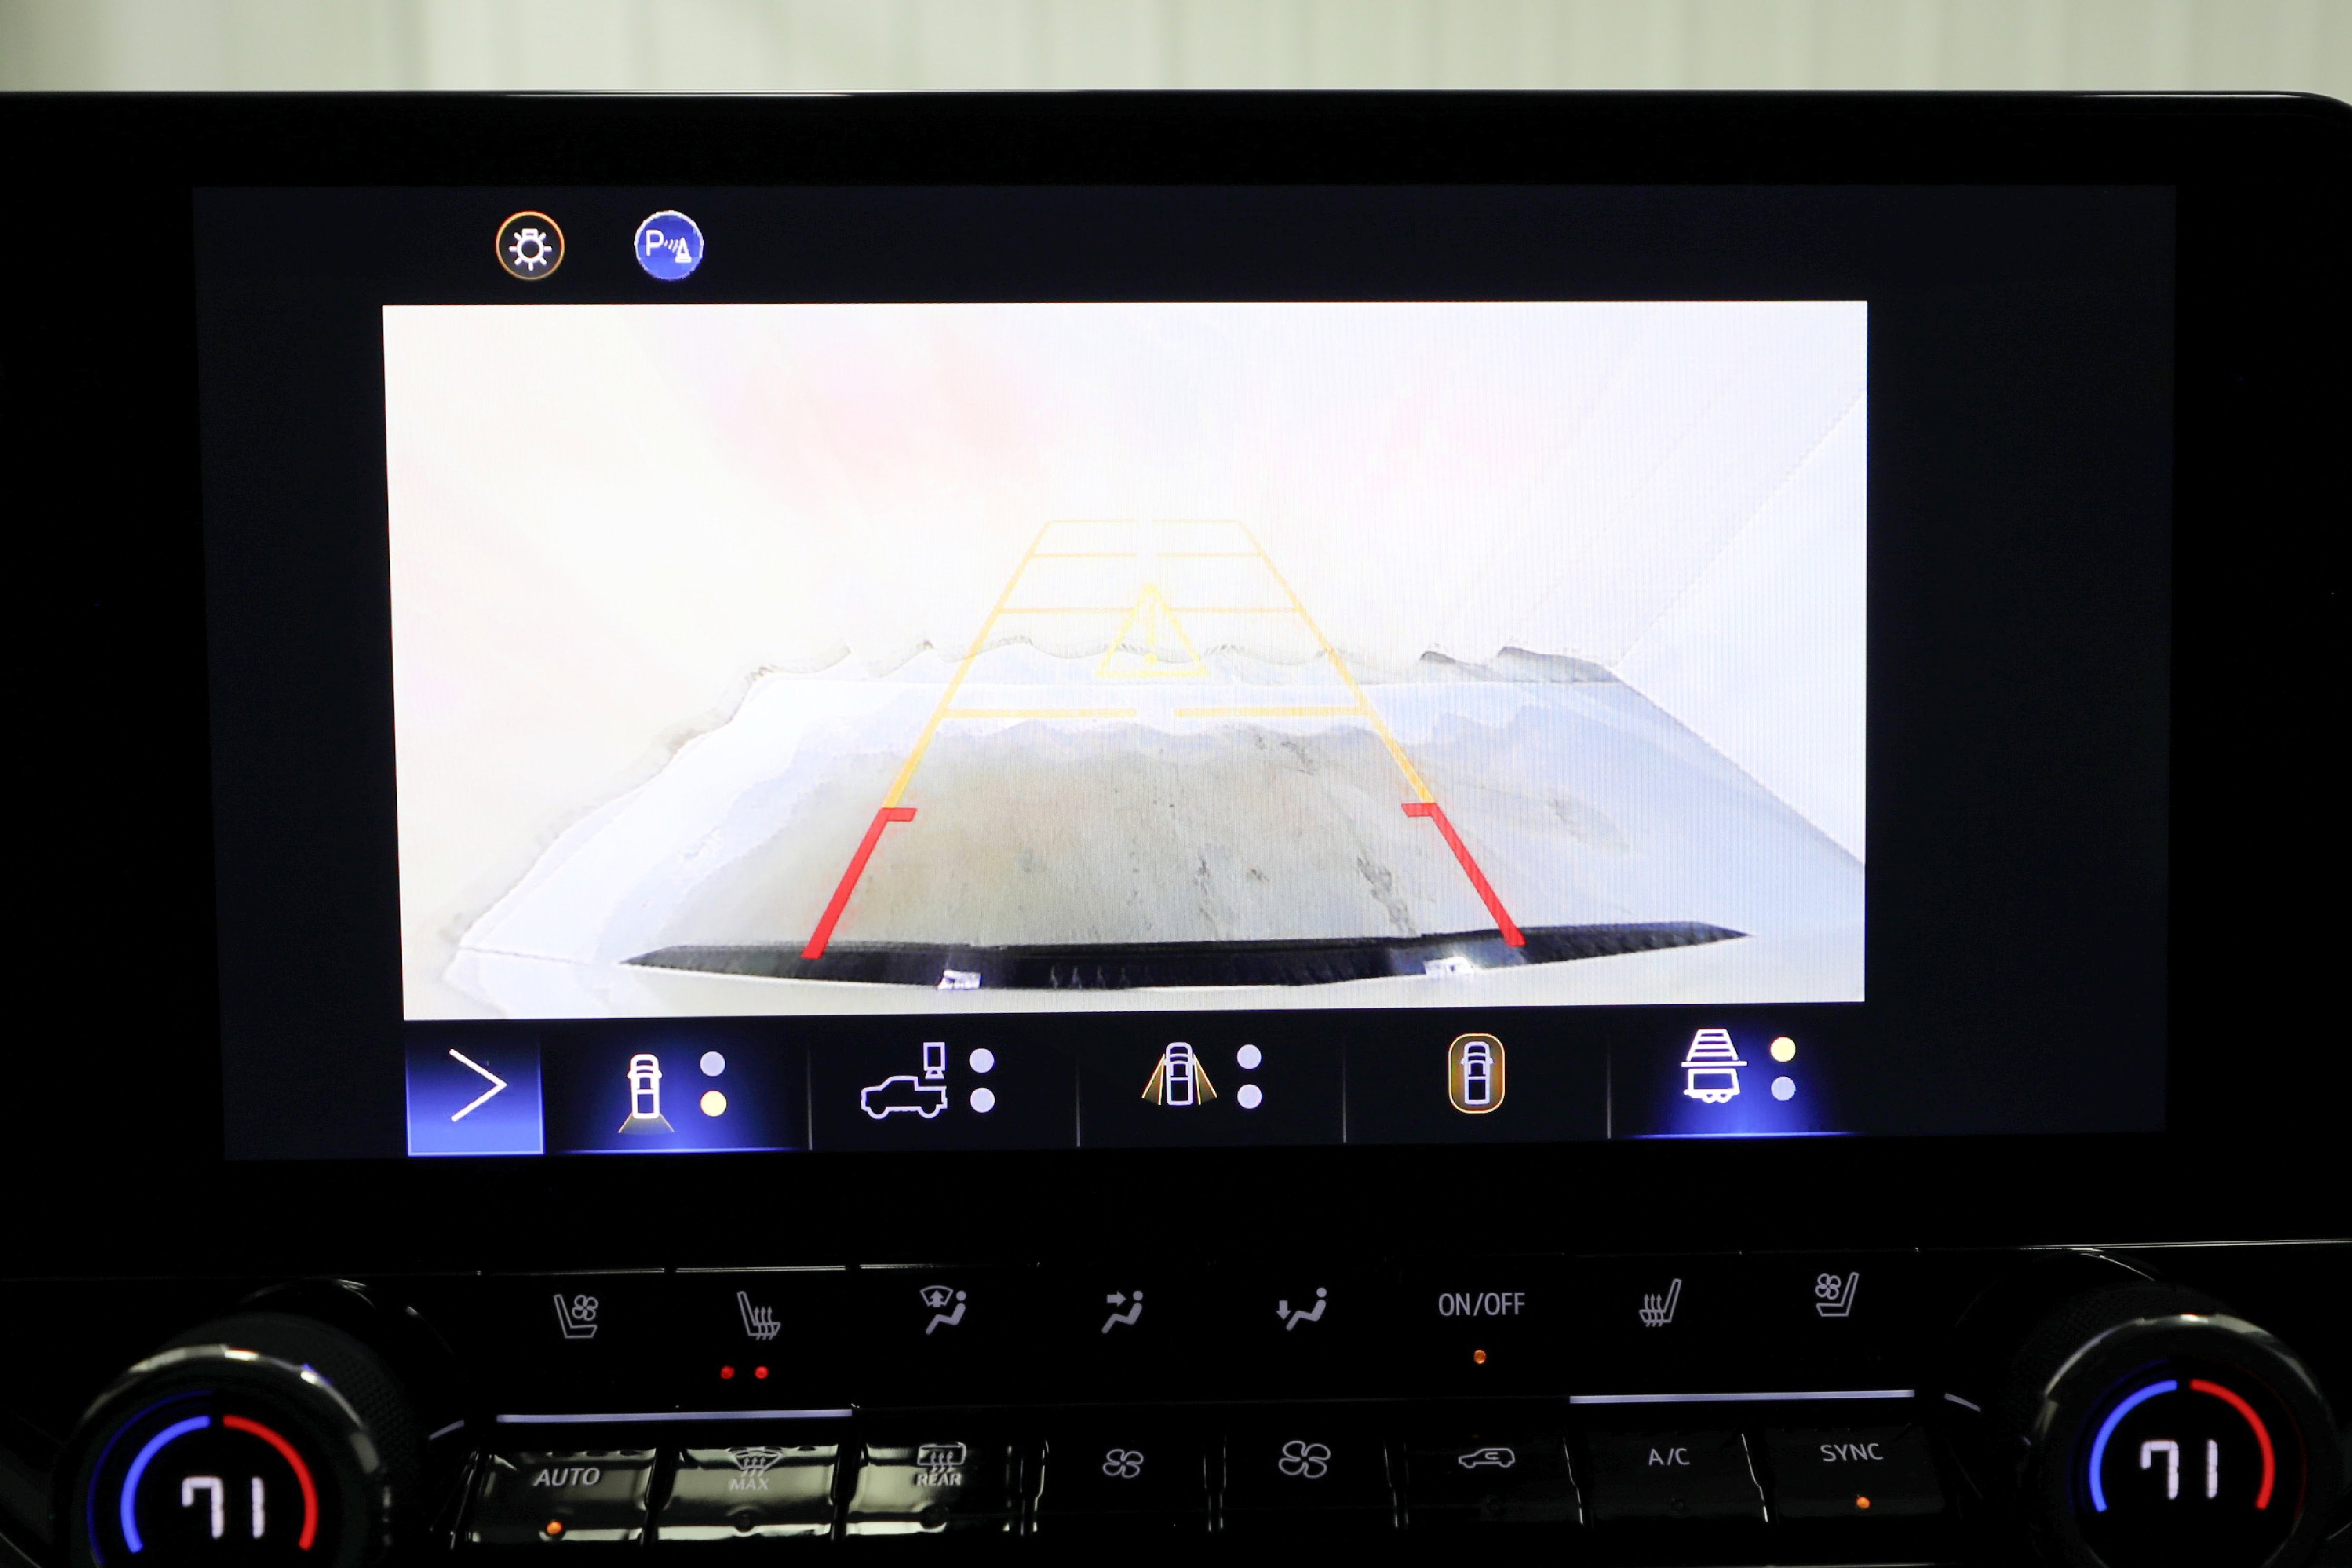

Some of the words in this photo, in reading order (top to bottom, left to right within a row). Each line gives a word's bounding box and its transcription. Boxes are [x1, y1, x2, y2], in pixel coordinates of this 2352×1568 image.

[645, 229, 665, 257] P
[1439, 1292, 1525, 1317] ON/OFF
[1648, 1447, 1691, 1466] A/C
[1820, 1443, 1884, 1462] SYNC
[533, 1466, 601, 1487] AUTO
[916, 1473, 962, 1487] REAR
[2140, 1439, 2219, 1500] 71
[729, 1478, 770, 1491] MAX
[180, 1475, 266, 1539] 71
